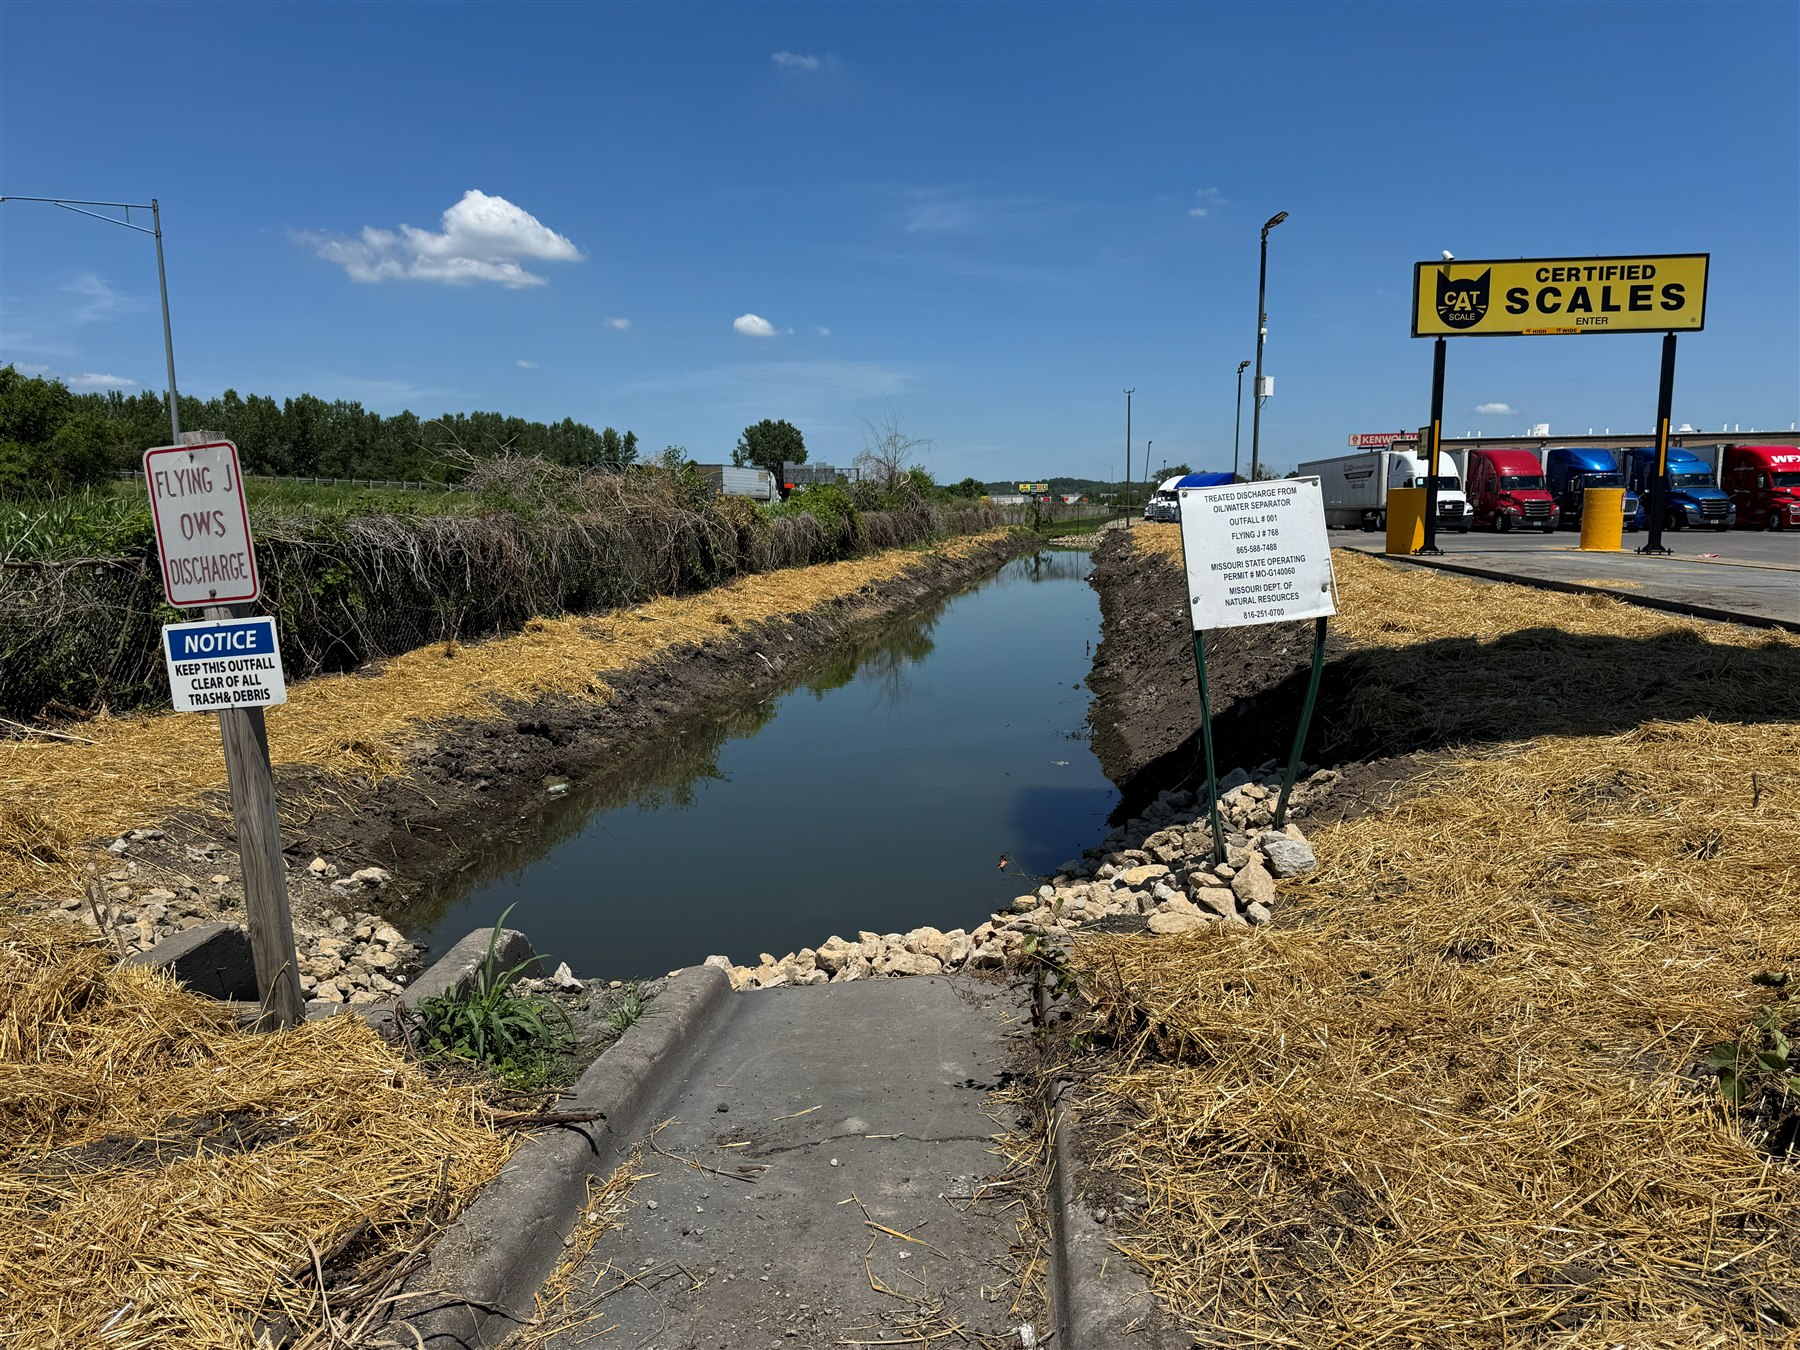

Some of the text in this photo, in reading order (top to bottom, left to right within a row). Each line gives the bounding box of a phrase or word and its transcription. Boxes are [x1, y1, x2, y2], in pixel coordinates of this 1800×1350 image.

[1535, 264, 1656, 283] CERTIFIED
[1444, 290, 1480, 312] CAT
[1505, 283, 1686, 315] SCALES
[1448, 312, 1476, 321] SCALE
[1575, 316, 1609, 326] ENTER
[154, 464, 234, 499] FLYING J
[1204, 486, 1297, 503] TREATED DISCHARGE FROM
[1213, 498, 1291, 513] OIL/WATER SEPARATOR
[180, 510, 227, 540] OWS
[1229, 517, 1260, 526] OUTFALL
[1266, 514, 1278, 522] 001
[1231, 530, 1256, 540] FLYING
[1267, 528, 1279, 537] 768
[1236, 543, 1278, 554] 865-588-7488
[170, 552, 248, 585] DISCHARGE
[1210, 555, 1306, 571] MISSOURI STATE OPERATING
[1223, 571, 1248, 581] PERMIT
[1229, 582, 1293, 595] MISSOURI DEPT. OF
[1224, 592, 1300, 607] NATURAL RESOURCES
[1243, 608, 1285, 619] 816-251-0700
[184, 630, 257, 654] NOTICE
[175, 657, 275, 676] KEEP THIS OUTFALL
[191, 673, 262, 691] CLEAR OF ALL
[233, 688, 271, 703] DEBRIS
